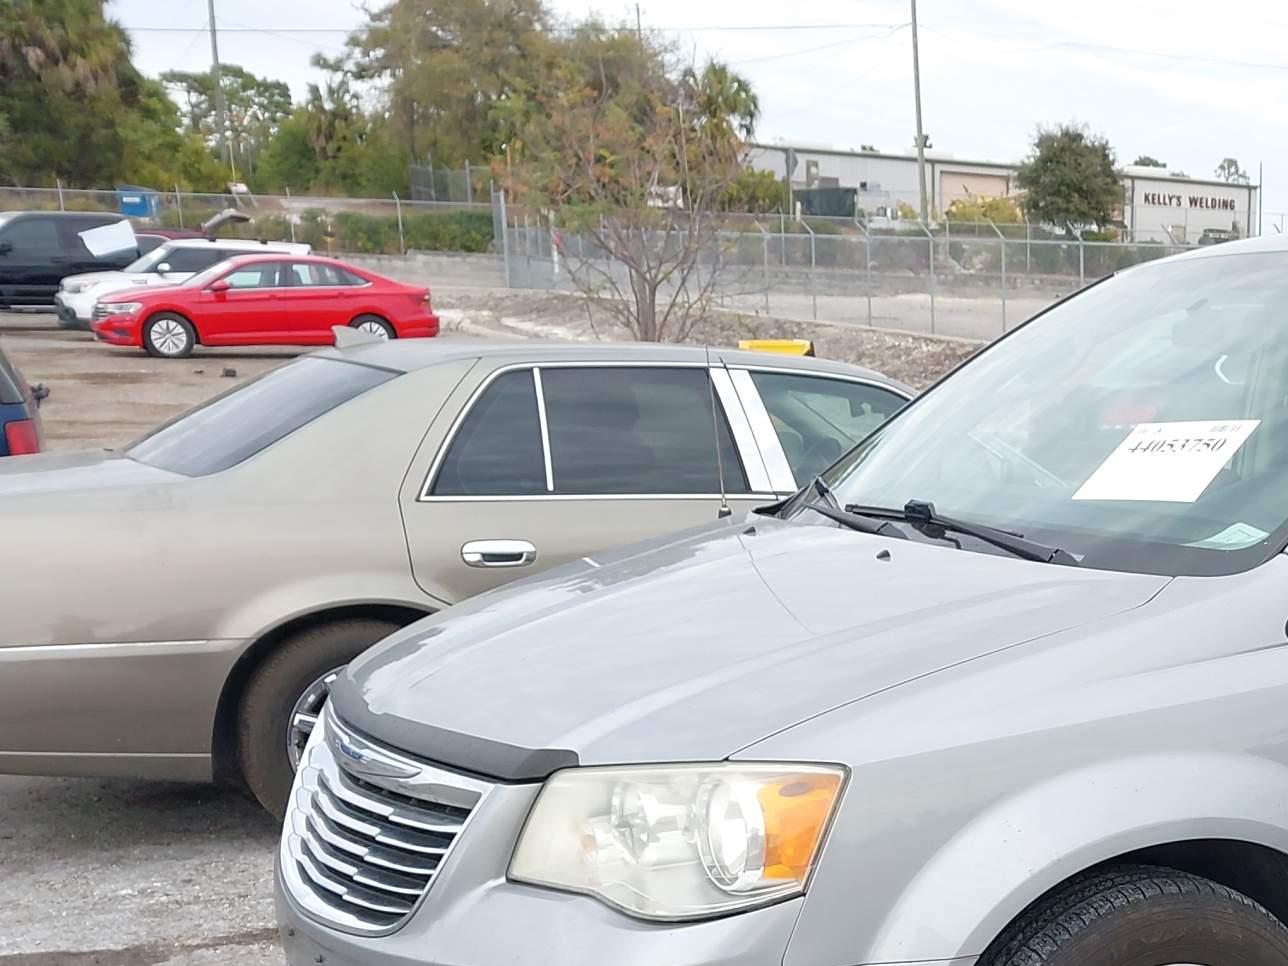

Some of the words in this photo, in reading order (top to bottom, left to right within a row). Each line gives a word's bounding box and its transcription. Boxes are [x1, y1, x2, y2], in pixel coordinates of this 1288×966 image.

[1144, 193, 1183, 207] KELLY'S
[1189, 196, 1235, 210] WELDING
[1128, 438, 1227, 453] 44053750
